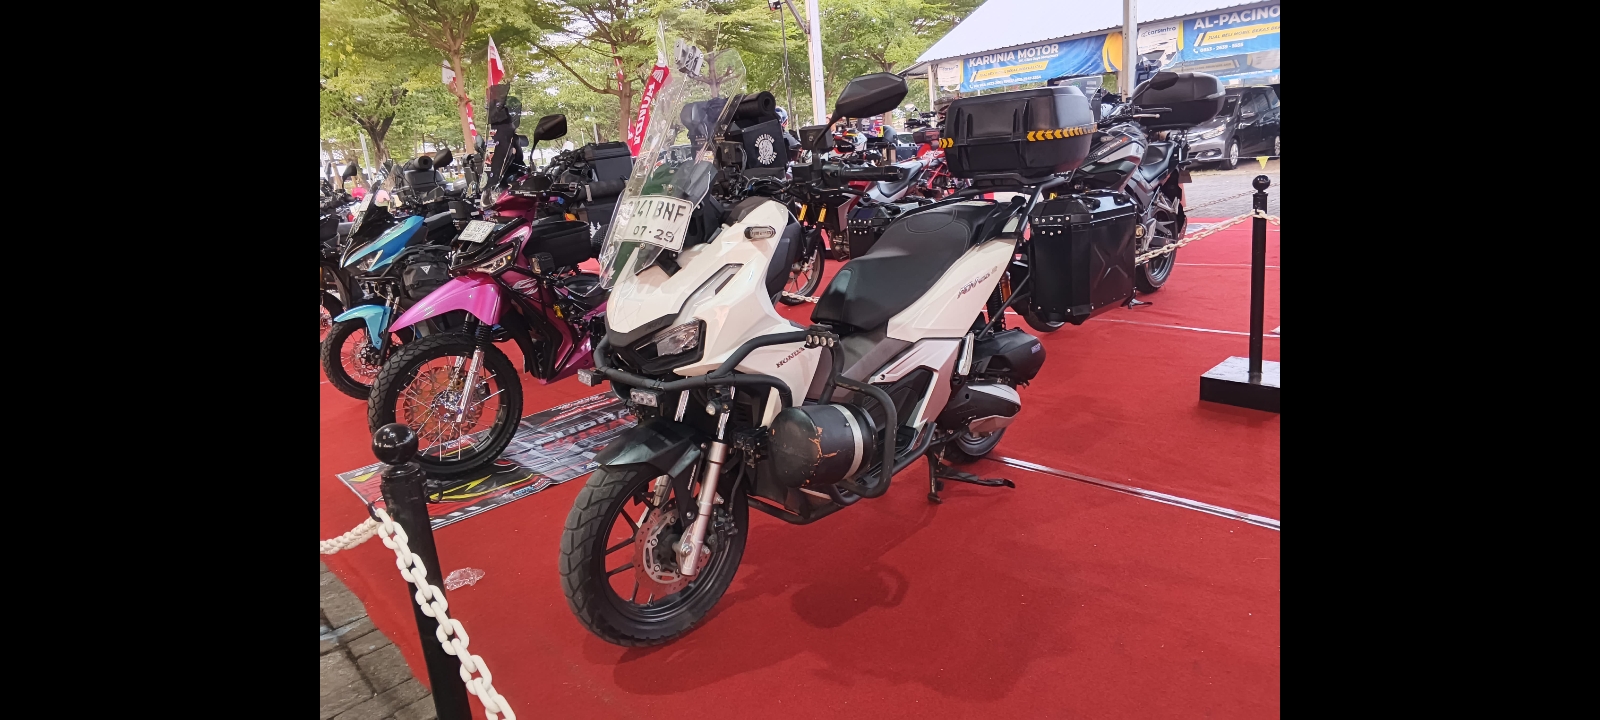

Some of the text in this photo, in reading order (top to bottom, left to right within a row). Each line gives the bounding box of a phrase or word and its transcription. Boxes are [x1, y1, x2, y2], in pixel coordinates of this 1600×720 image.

[1193, 5, 1280, 30] AL-PACINO
[969, 52, 1015, 67] KARUNIA
[1018, 44, 1058, 61] MOTOR
[652, 200, 687, 223] BNF
[775, 346, 806, 369] HONDA
